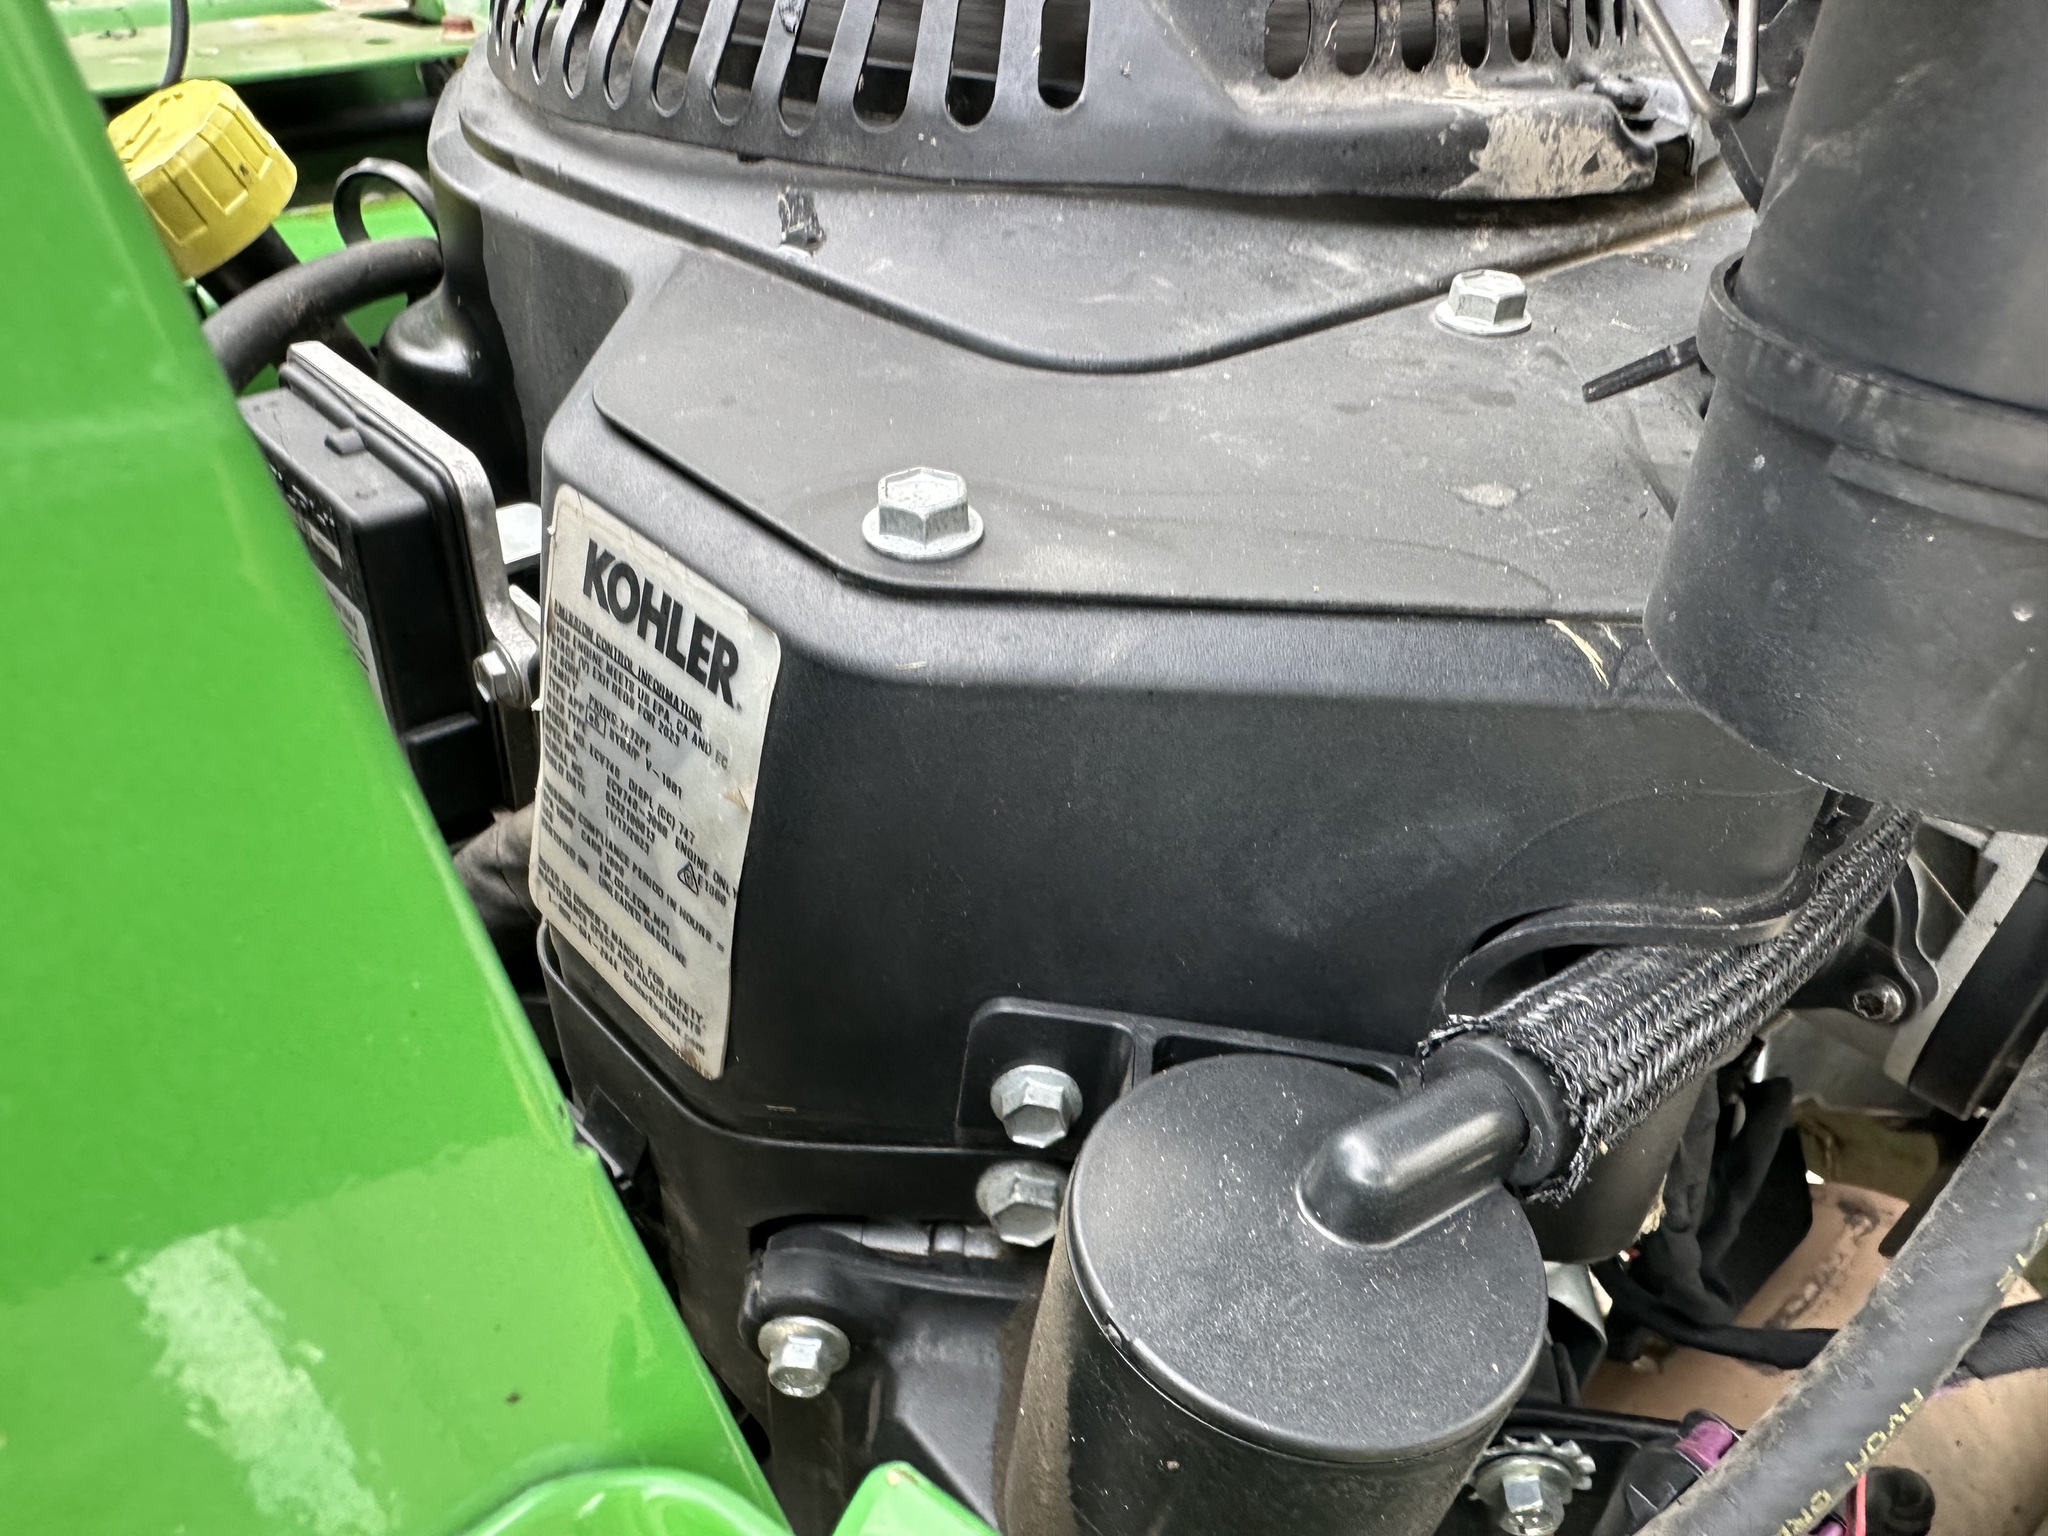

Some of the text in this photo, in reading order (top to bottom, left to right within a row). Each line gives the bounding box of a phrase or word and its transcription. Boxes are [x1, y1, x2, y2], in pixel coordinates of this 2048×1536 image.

[582, 538, 739, 710] KOHLER
[548, 675, 563, 699] TYPE
[549, 660, 577, 693] FAMILY
[573, 634, 602, 669] ENGINE
[606, 660, 634, 695] MEETS
[652, 698, 673, 728] EPA,
[595, 632, 632, 673] CONTROL
[638, 665, 703, 731] INFORMATION
[546, 704, 569, 736] MODEL
[567, 708, 585, 734] TYPE
[565, 769, 586, 798] DATE
[578, 810, 629, 868] COMPLIANCE
[632, 860, 663, 899] PERIOD
[679, 905, 711, 943] HOURS
[674, 835, 708, 876] ENGINE
[598, 873, 641, 924] UNLEADED
[643, 918, 687, 968] GASOLINE
[611, 928, 644, 970] MANUAL
[636, 966, 701, 1038] ADJUSTMENTS
